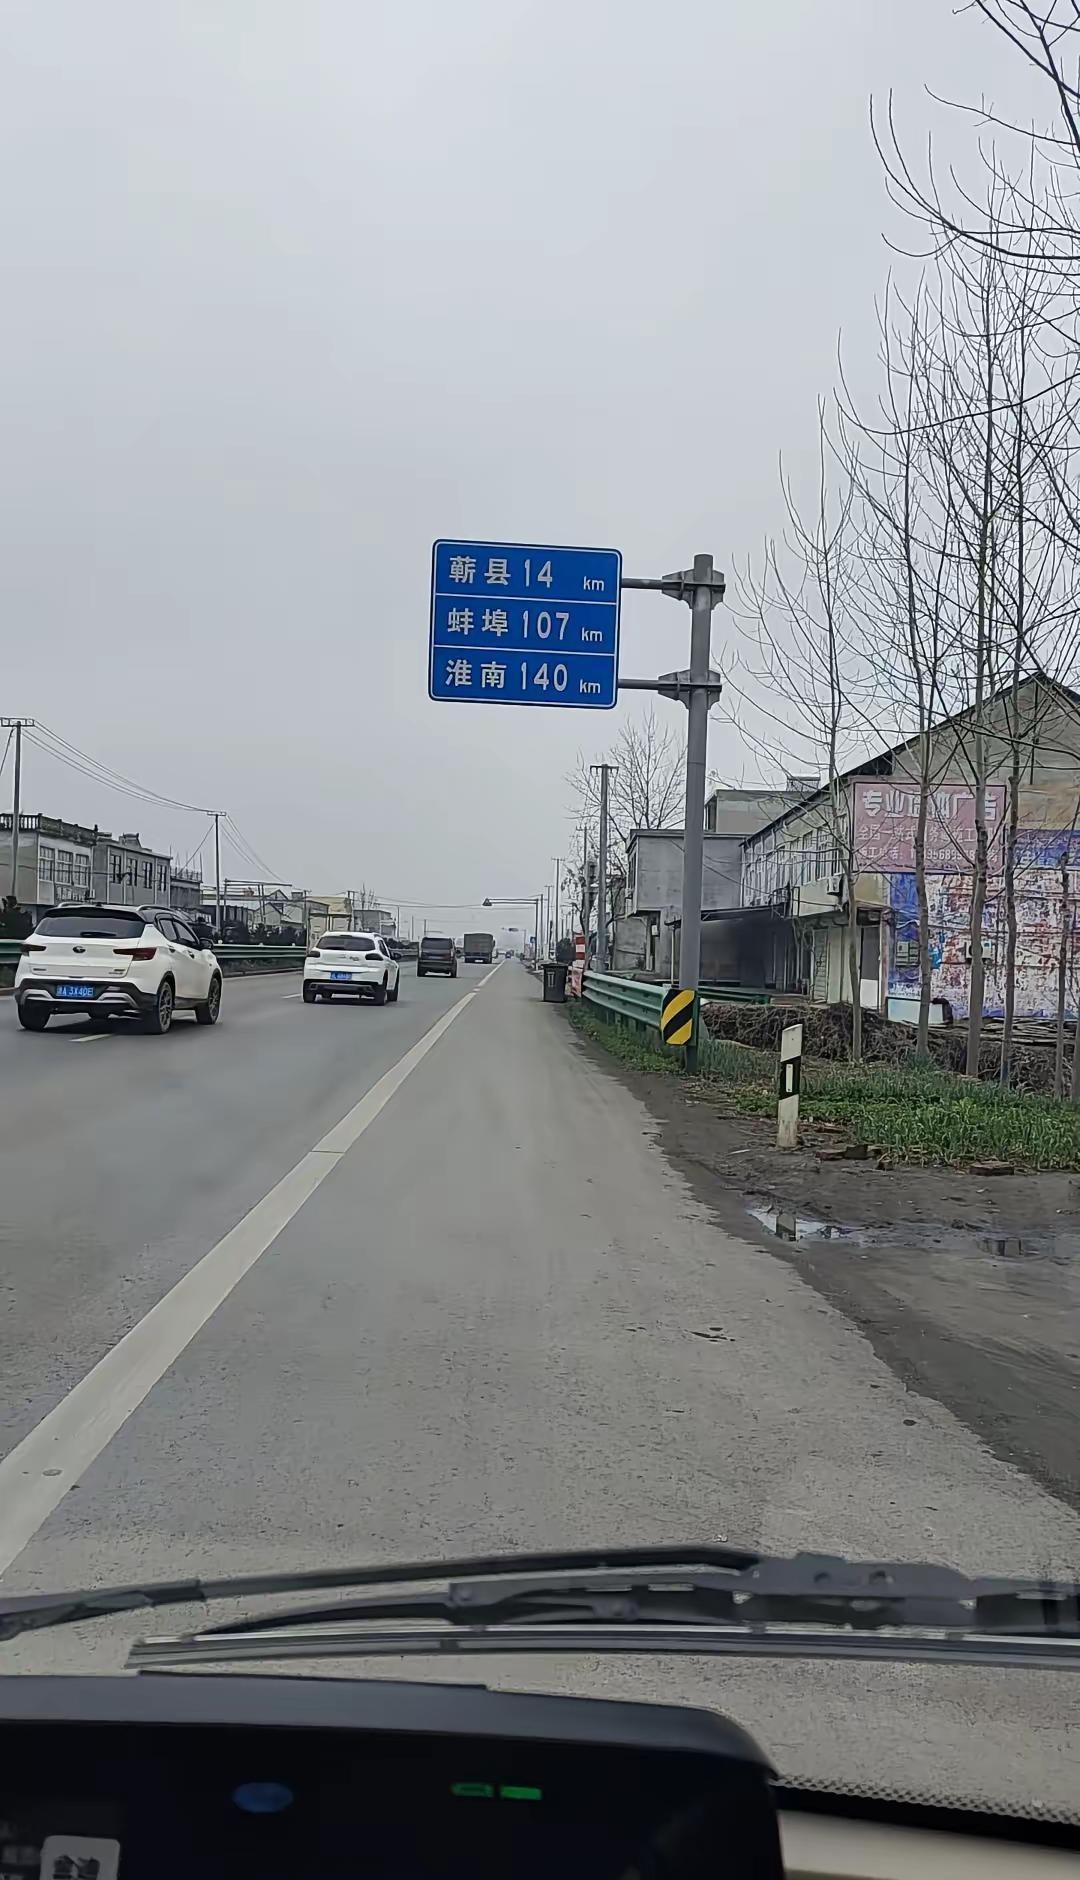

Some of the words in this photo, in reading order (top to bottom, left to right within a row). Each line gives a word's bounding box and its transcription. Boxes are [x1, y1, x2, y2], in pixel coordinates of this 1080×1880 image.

[449, 556, 511, 586] 蕲县
[524, 559, 553, 588] 14
[583, 576, 605, 591] km
[447, 607, 509, 636] 蚌埠
[522, 610, 570, 640] 107
[581, 627, 603, 642] km
[445, 659, 507, 689] 淮南
[520, 662, 568, 692] 140
[579, 678, 601, 694] km
